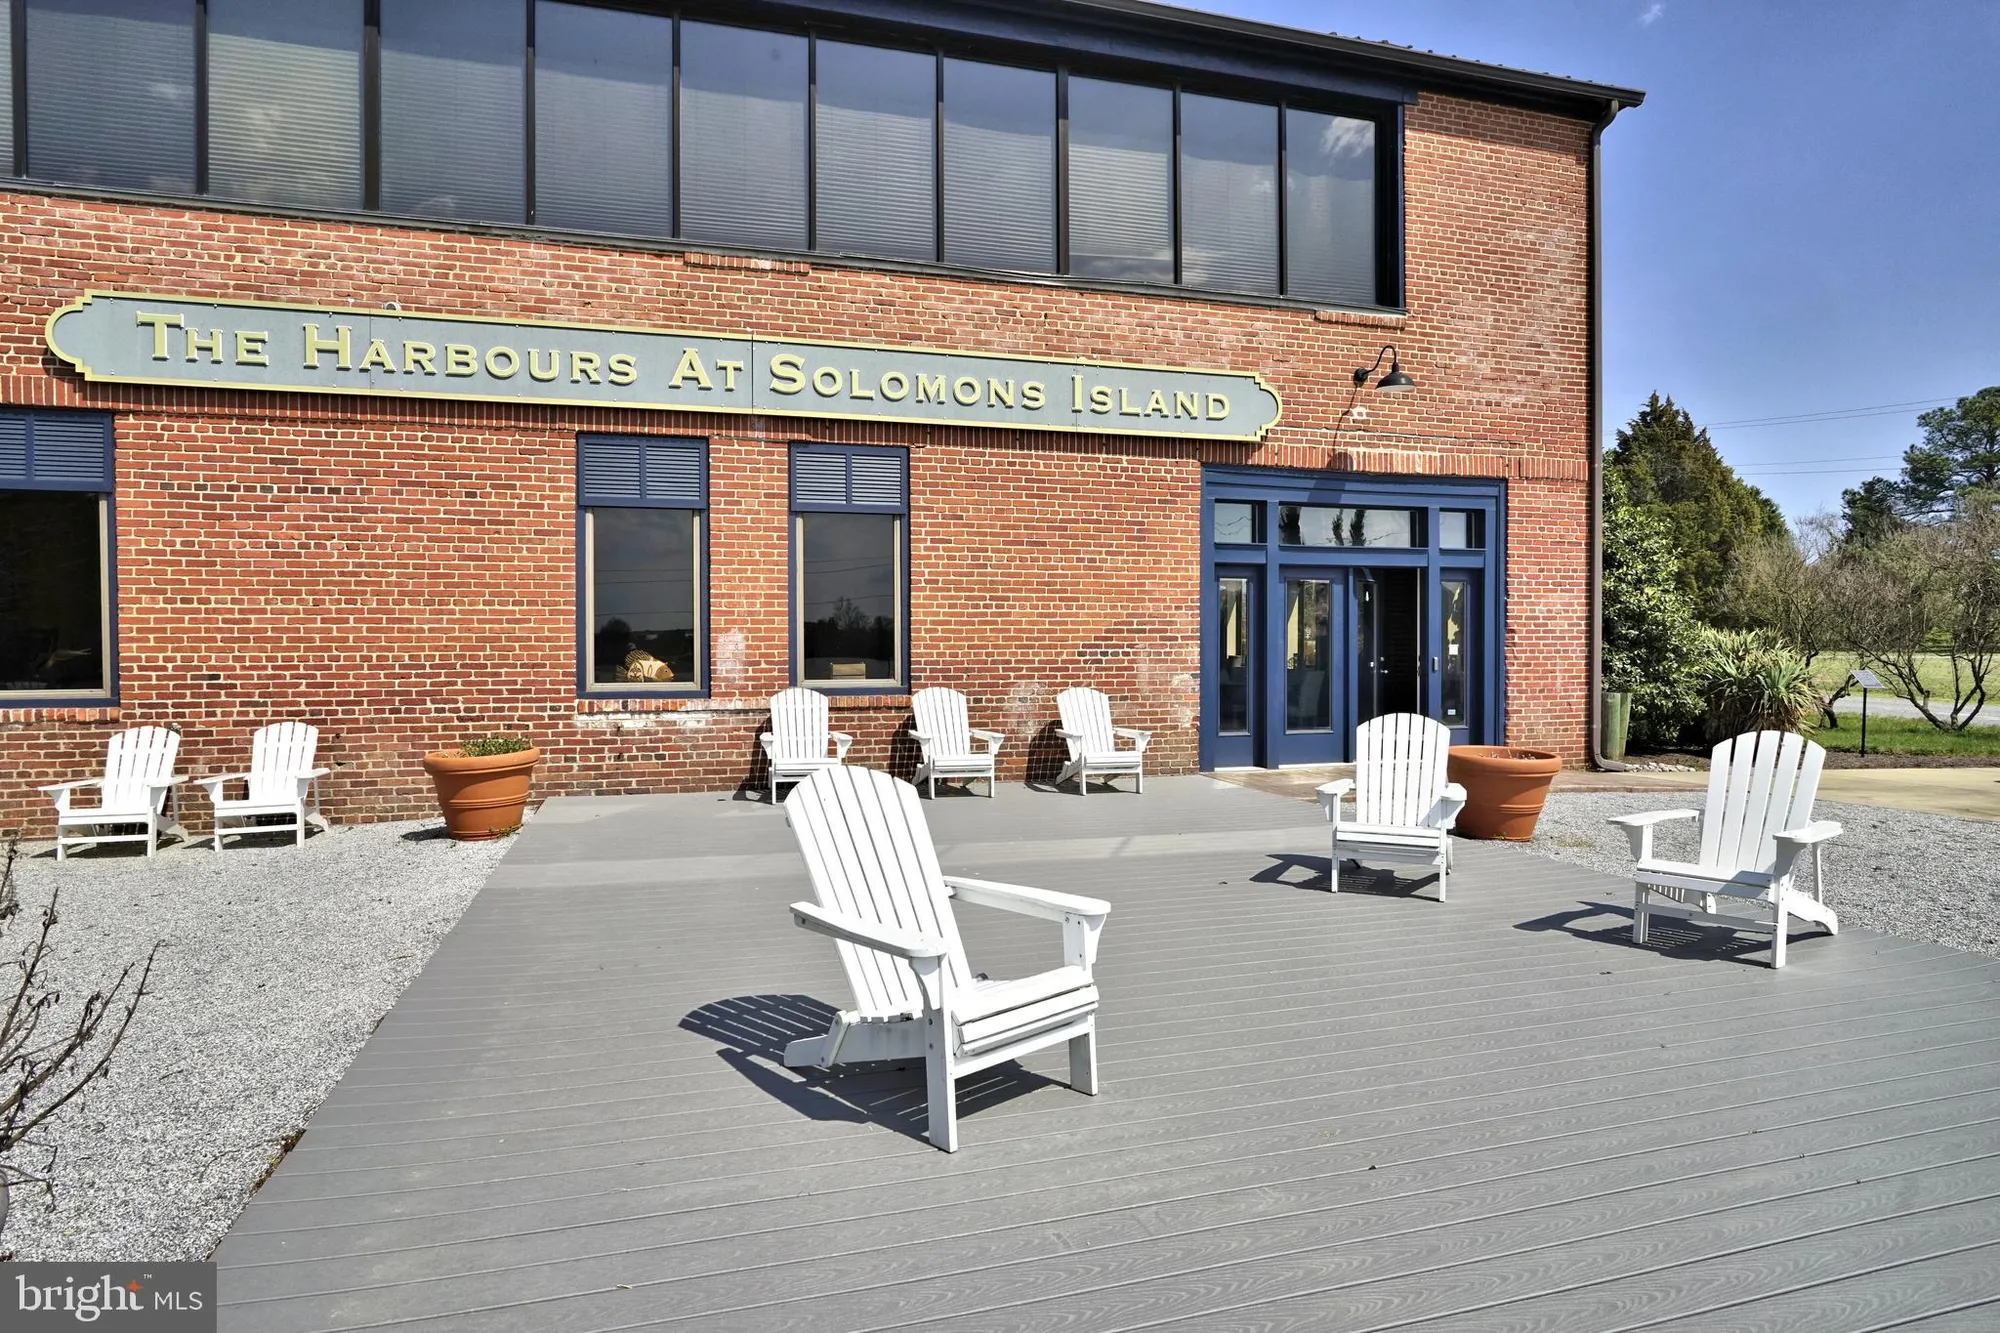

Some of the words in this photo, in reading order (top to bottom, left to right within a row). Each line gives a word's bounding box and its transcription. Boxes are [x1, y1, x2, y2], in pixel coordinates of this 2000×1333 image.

[136, 311, 269, 366] THE
[303, 323, 638, 385] HARBOURS
[669, 347, 743, 390] AT
[769, 354, 1046, 409] SOLOMONS
[1071, 374, 1231, 420] ISLAND
